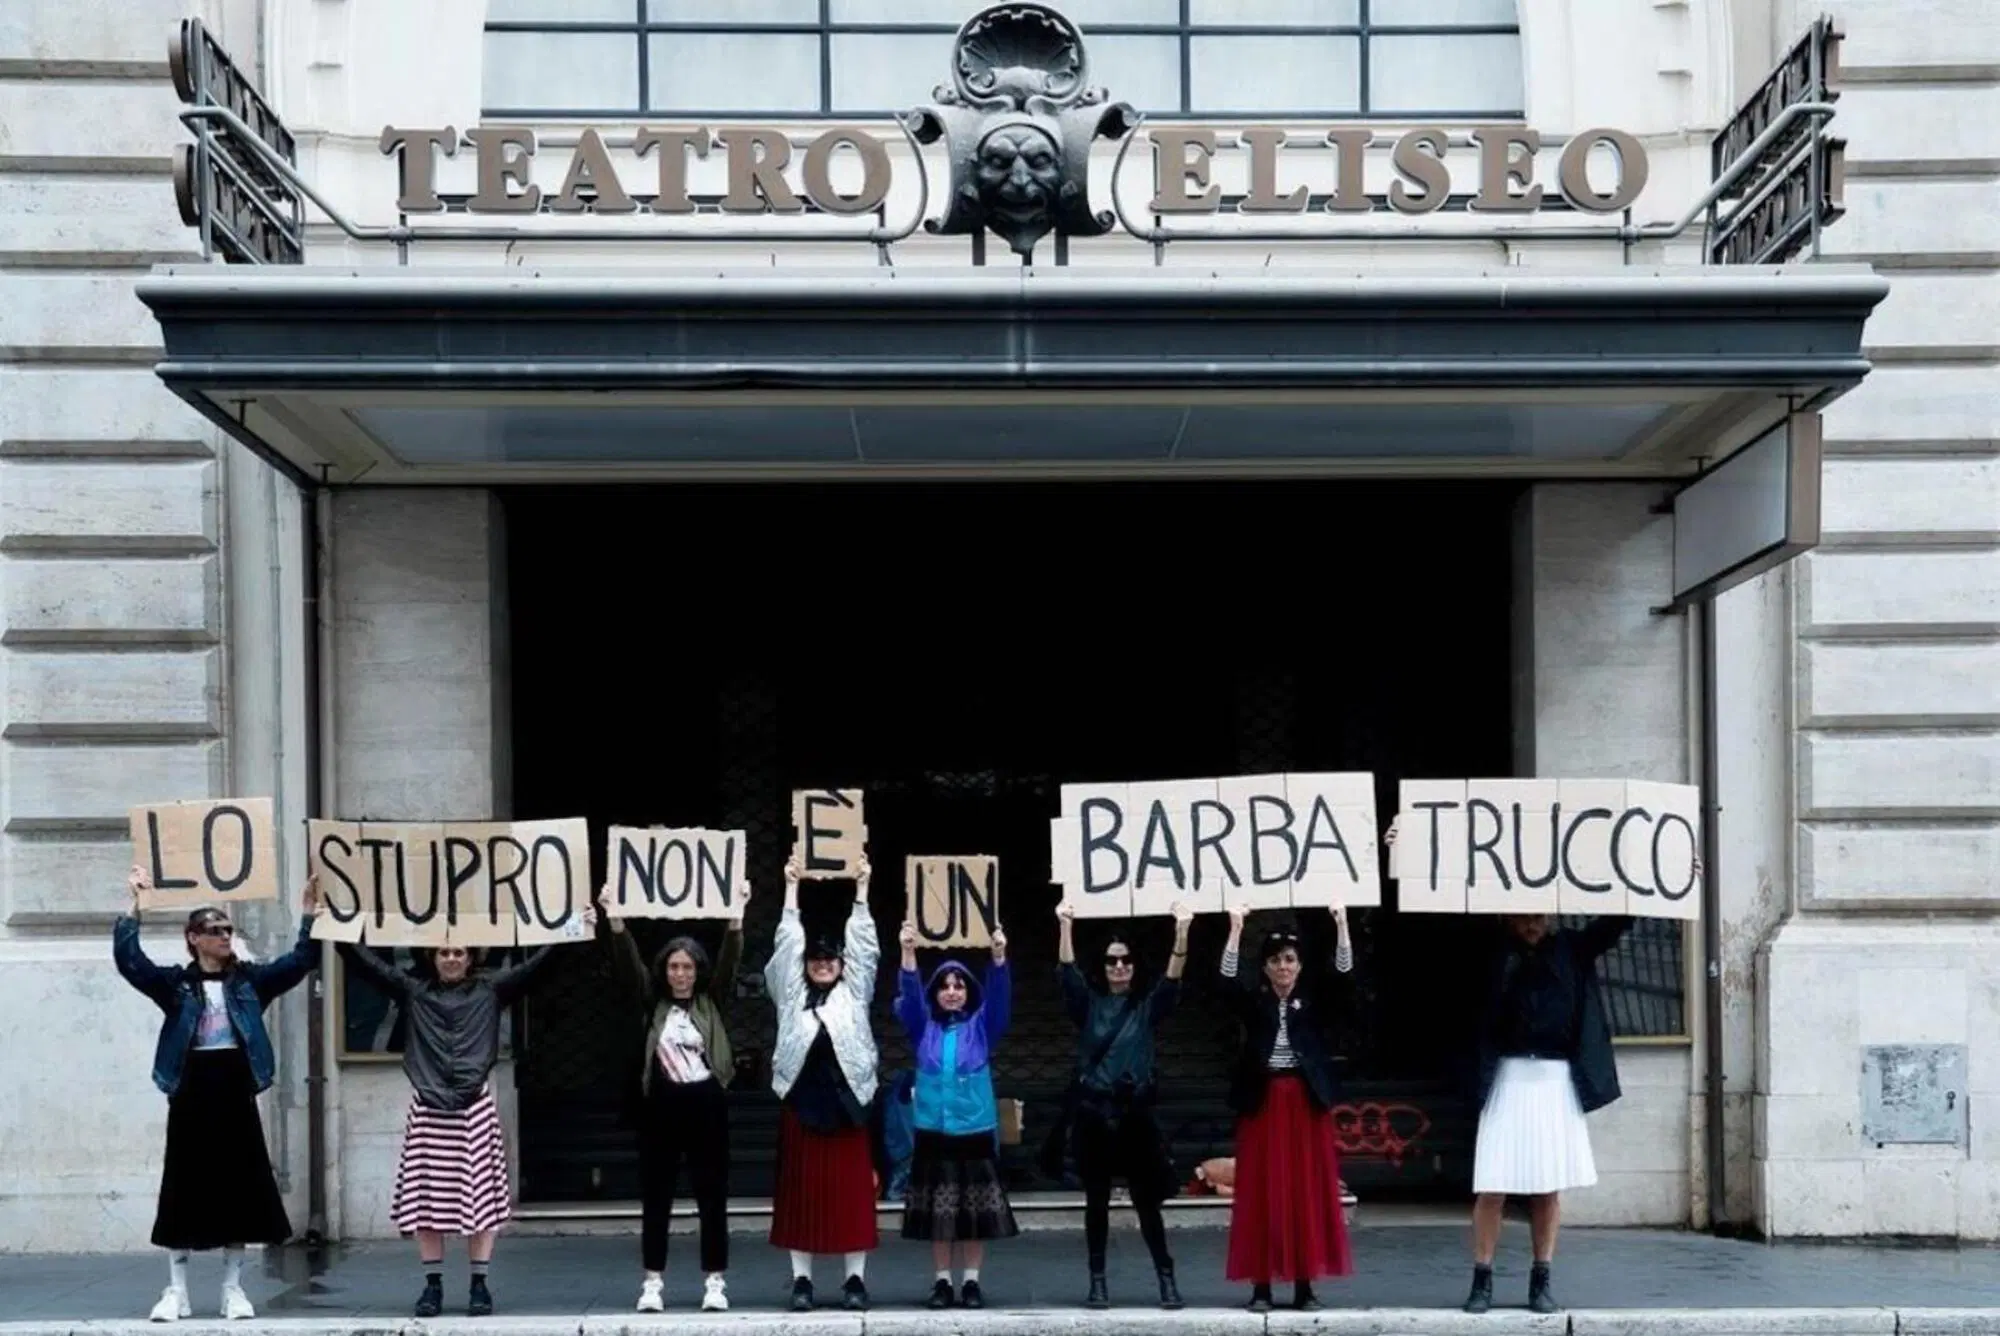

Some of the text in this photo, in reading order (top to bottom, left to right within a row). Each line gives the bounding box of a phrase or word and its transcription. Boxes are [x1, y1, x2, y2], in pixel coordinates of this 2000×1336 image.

[379, 125, 1650, 215] TEATRO ELISEO
[147, 805, 254, 892] LO
[618, 837, 735, 908] NON
[805, 789, 855, 871] È
[1080, 794, 1359, 893] BARBA
[1412, 797, 1697, 900] TRUCCO
[318, 834, 574, 930] STUPRO
[915, 861, 998, 941] UN
